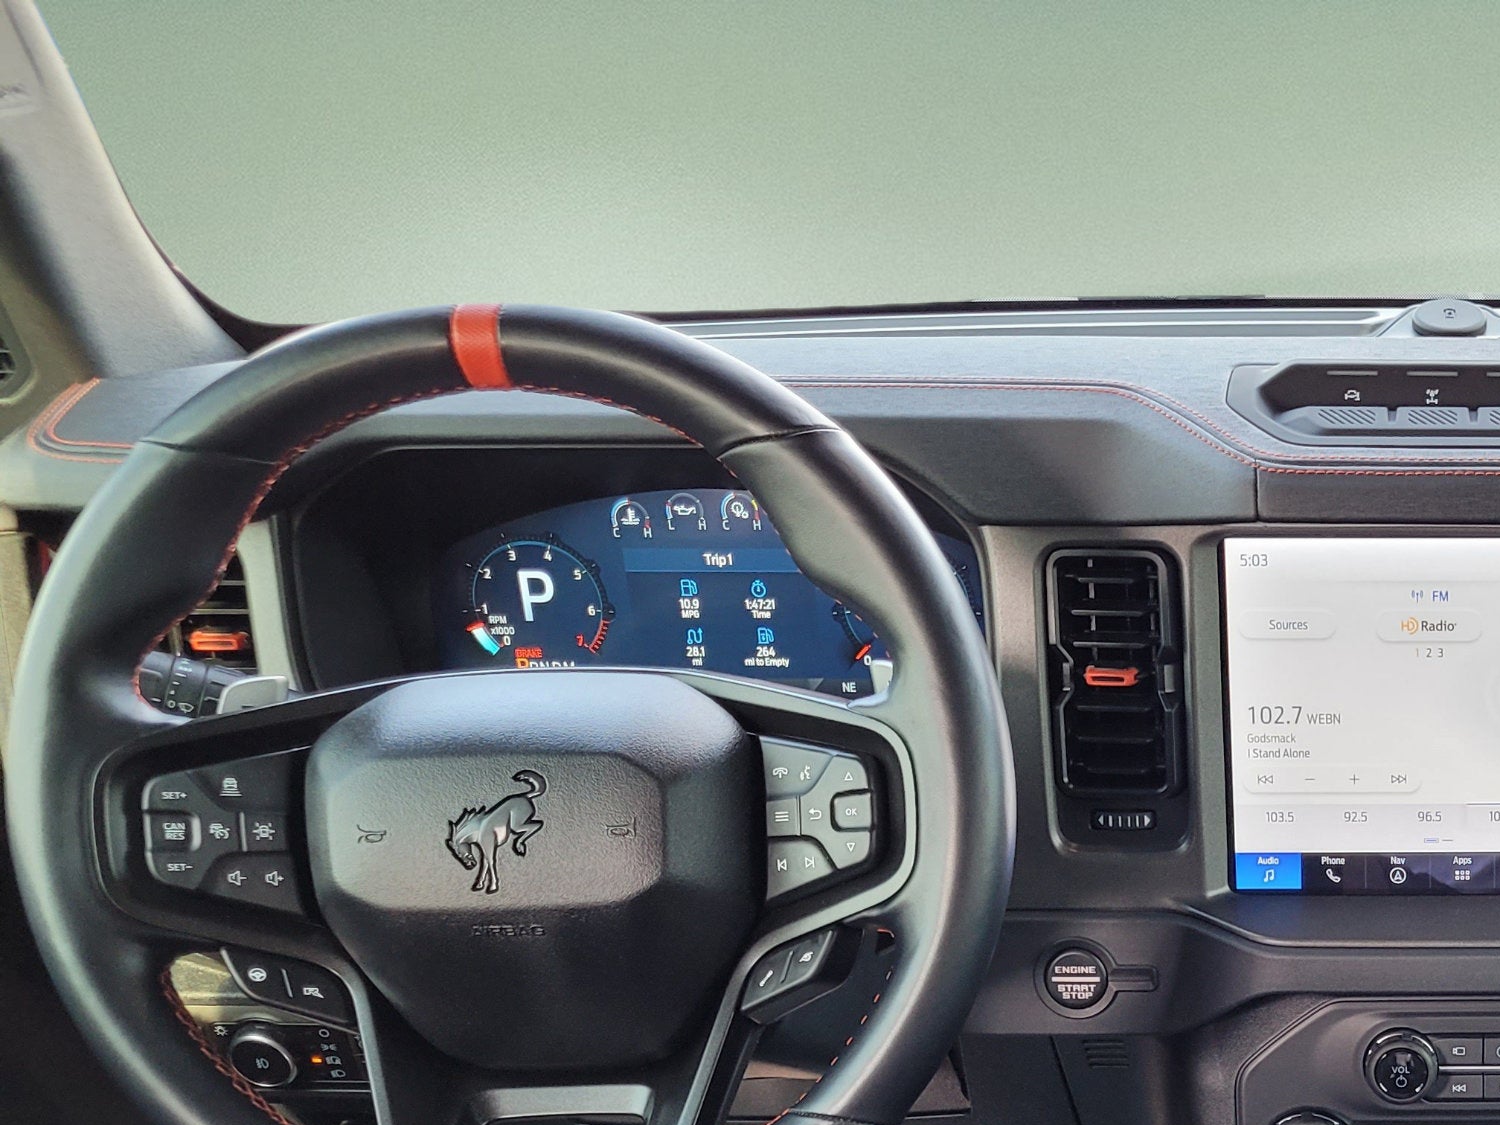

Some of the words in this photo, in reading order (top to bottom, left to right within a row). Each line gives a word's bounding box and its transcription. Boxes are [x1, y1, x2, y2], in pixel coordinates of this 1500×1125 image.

[507, 552, 516, 561] 3
[543, 552, 552, 561] 4
[1239, 554, 1268, 567] 5:03
[483, 569, 492, 580] 2
[573, 570, 582, 580] 5
[516, 569, 554, 622] P
[1432, 591, 1449, 602] FM
[679, 599, 700, 609] 10.9
[744, 599, 776, 610] 1:47:21
[587, 606, 596, 616] 6
[681, 610, 700, 619] MPG
[753, 610, 771, 619] Time
[488, 616, 507, 624] RPM
[490, 626, 515, 635] x1000
[1269, 620, 1308, 631] Sources
[1421, 620, 1455, 632] Radio
[503, 636, 511, 646] 0
[686, 647, 705, 657] 28.1
[756, 647, 775, 657] 264
[764, 658, 789, 667] Empty
[863, 655, 872, 666] 0
[842, 682, 857, 693] NE
[1248, 706, 1302, 725] 102.7
[1306, 713, 1342, 725] WEBN
[1247, 733, 1296, 744] Godsmack
[1252, 748, 1281, 758] Stand
[1283, 748, 1311, 758] Alone
[846, 808, 857, 816] OK
[1265, 811, 1295, 823] 103.5
[1343, 810, 1369, 822] 92.5
[1417, 810, 1442, 822] 96.5
[165, 832, 185, 840] RES
[1257, 856, 1279, 865] Audio
[1321, 856, 1345, 865] Phone
[1390, 856, 1406, 865] Nav
[1453, 856, 1472, 866] Apps
[1054, 966, 1096, 974] ENGINE
[1057, 984, 1096, 992] START
